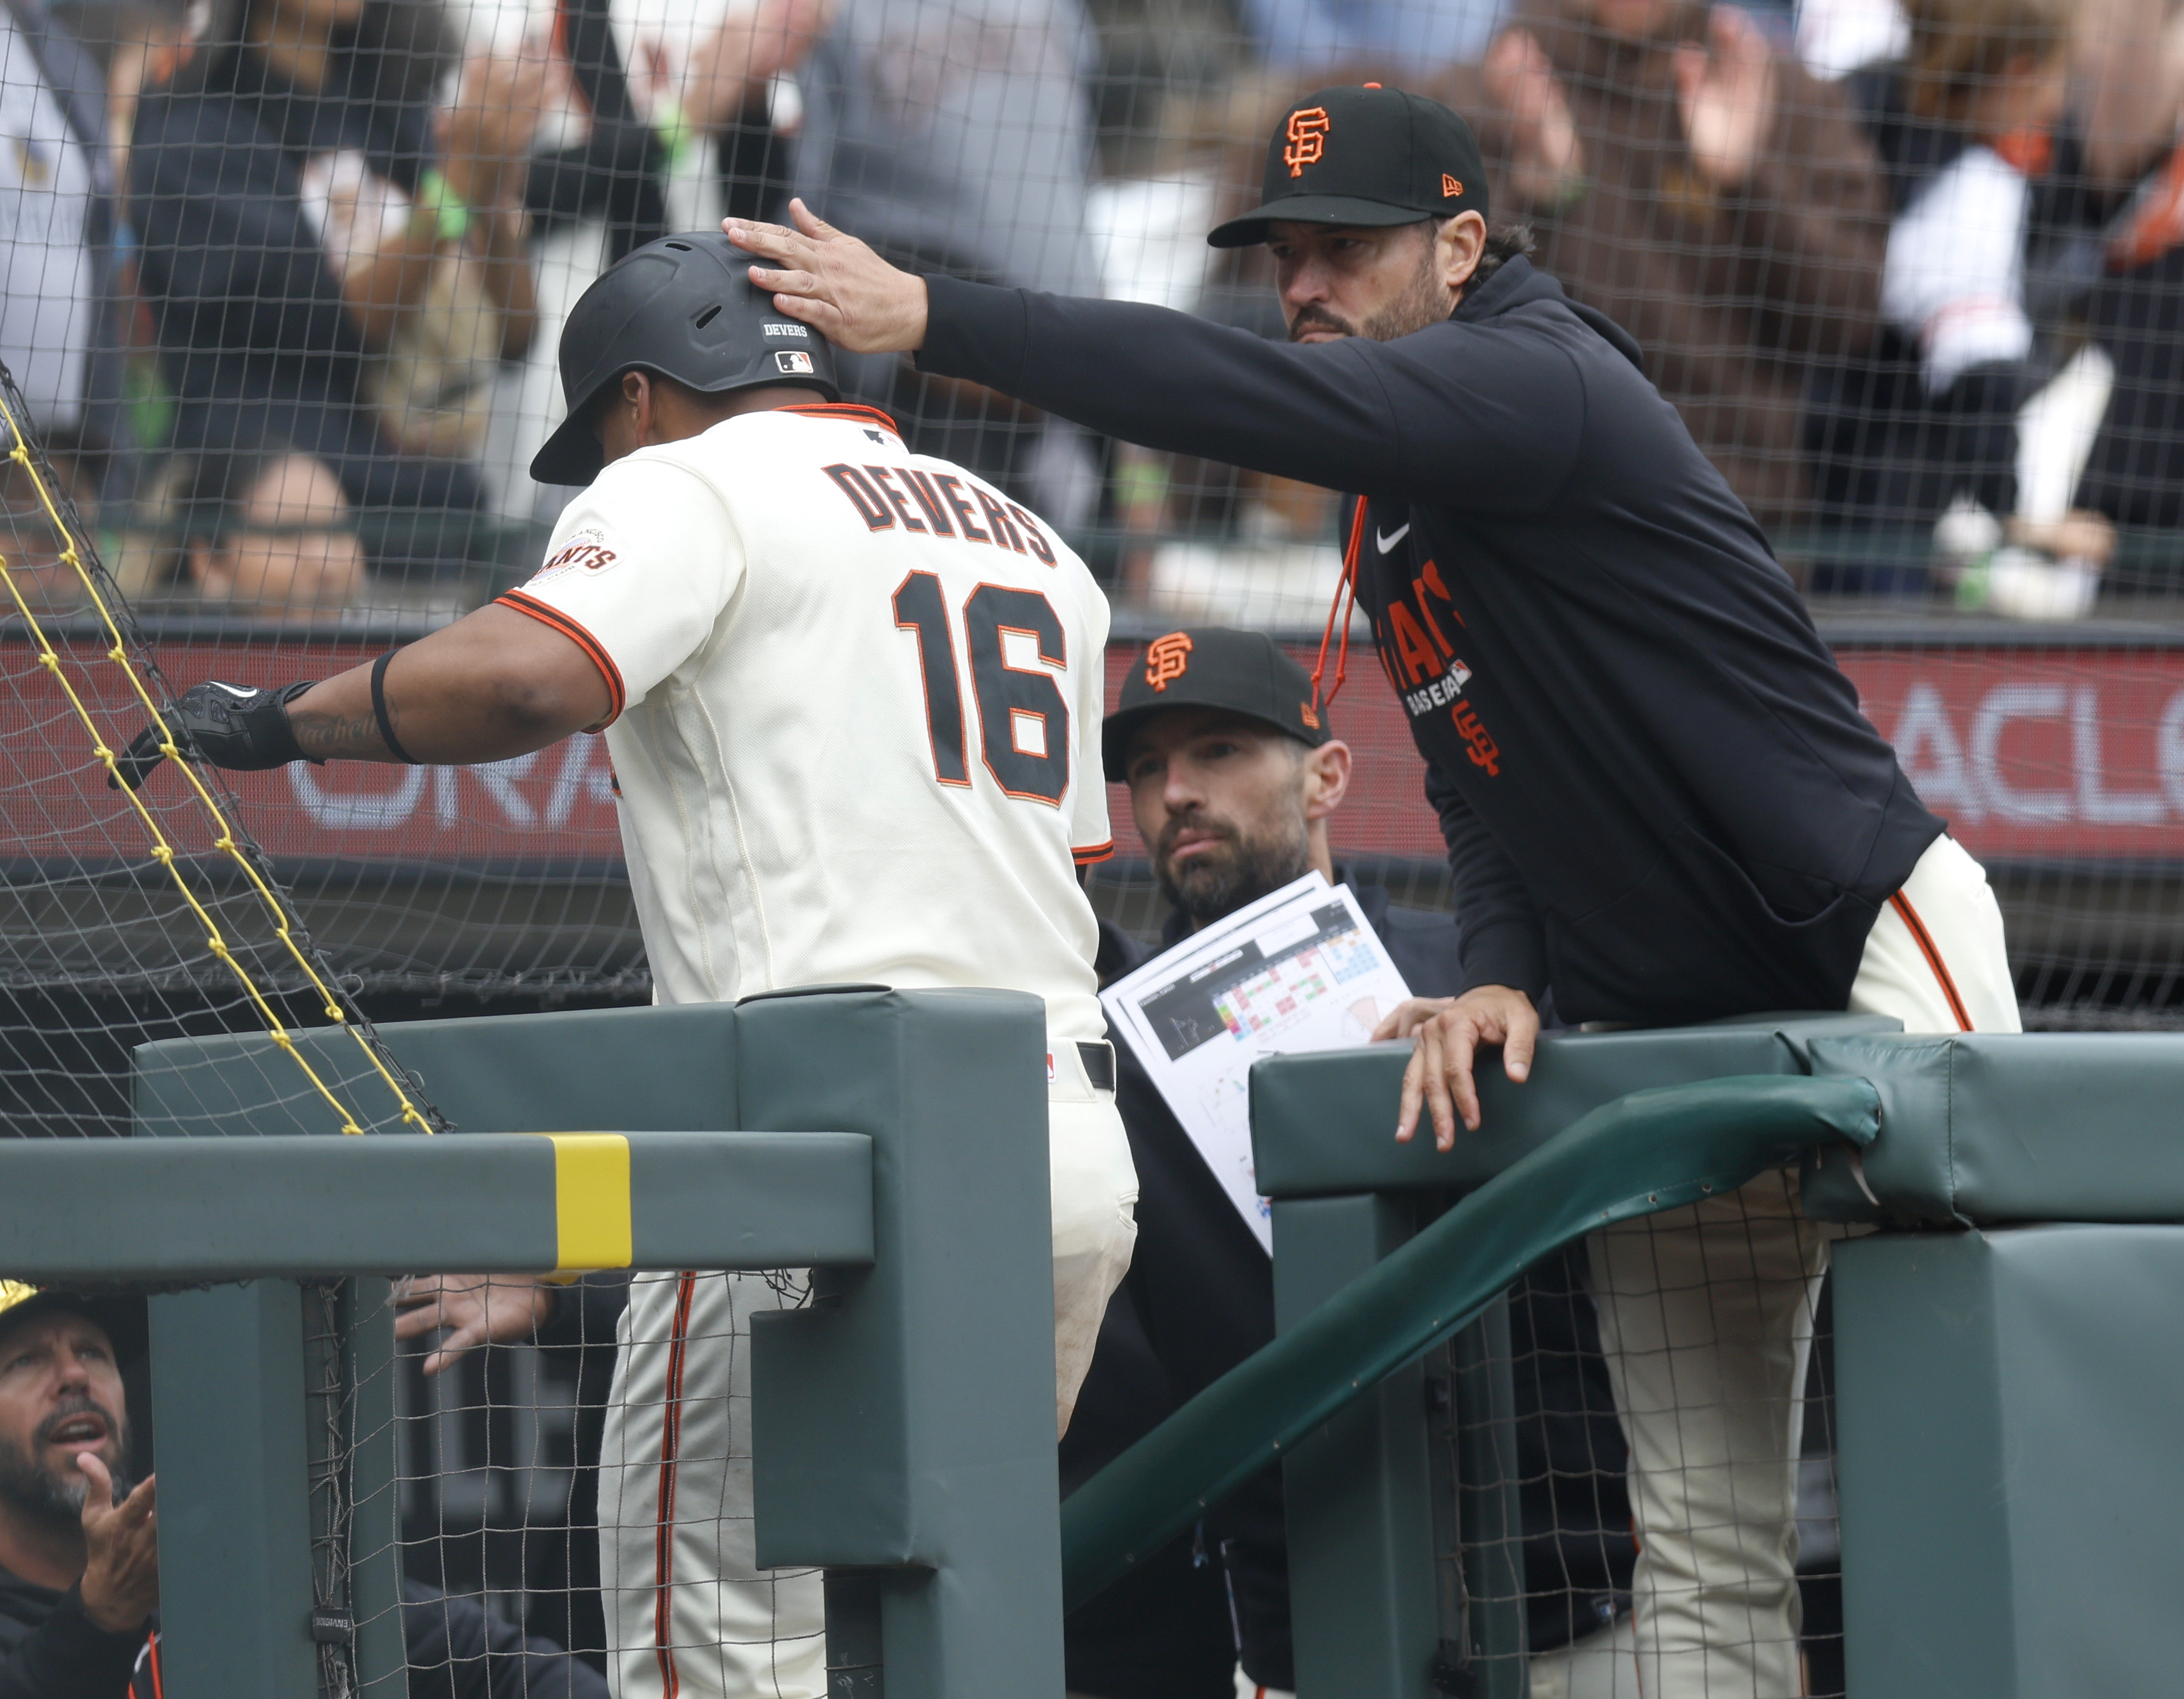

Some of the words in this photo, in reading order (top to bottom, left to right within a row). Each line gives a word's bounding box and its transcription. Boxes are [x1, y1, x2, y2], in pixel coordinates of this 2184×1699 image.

[764, 324, 808, 337] DEVERS
[536, 545, 617, 570] ANTS
[821, 463, 1058, 569] DEVERS
[891, 569, 1070, 810] 16
[1891, 680, 2184, 826] ACL
